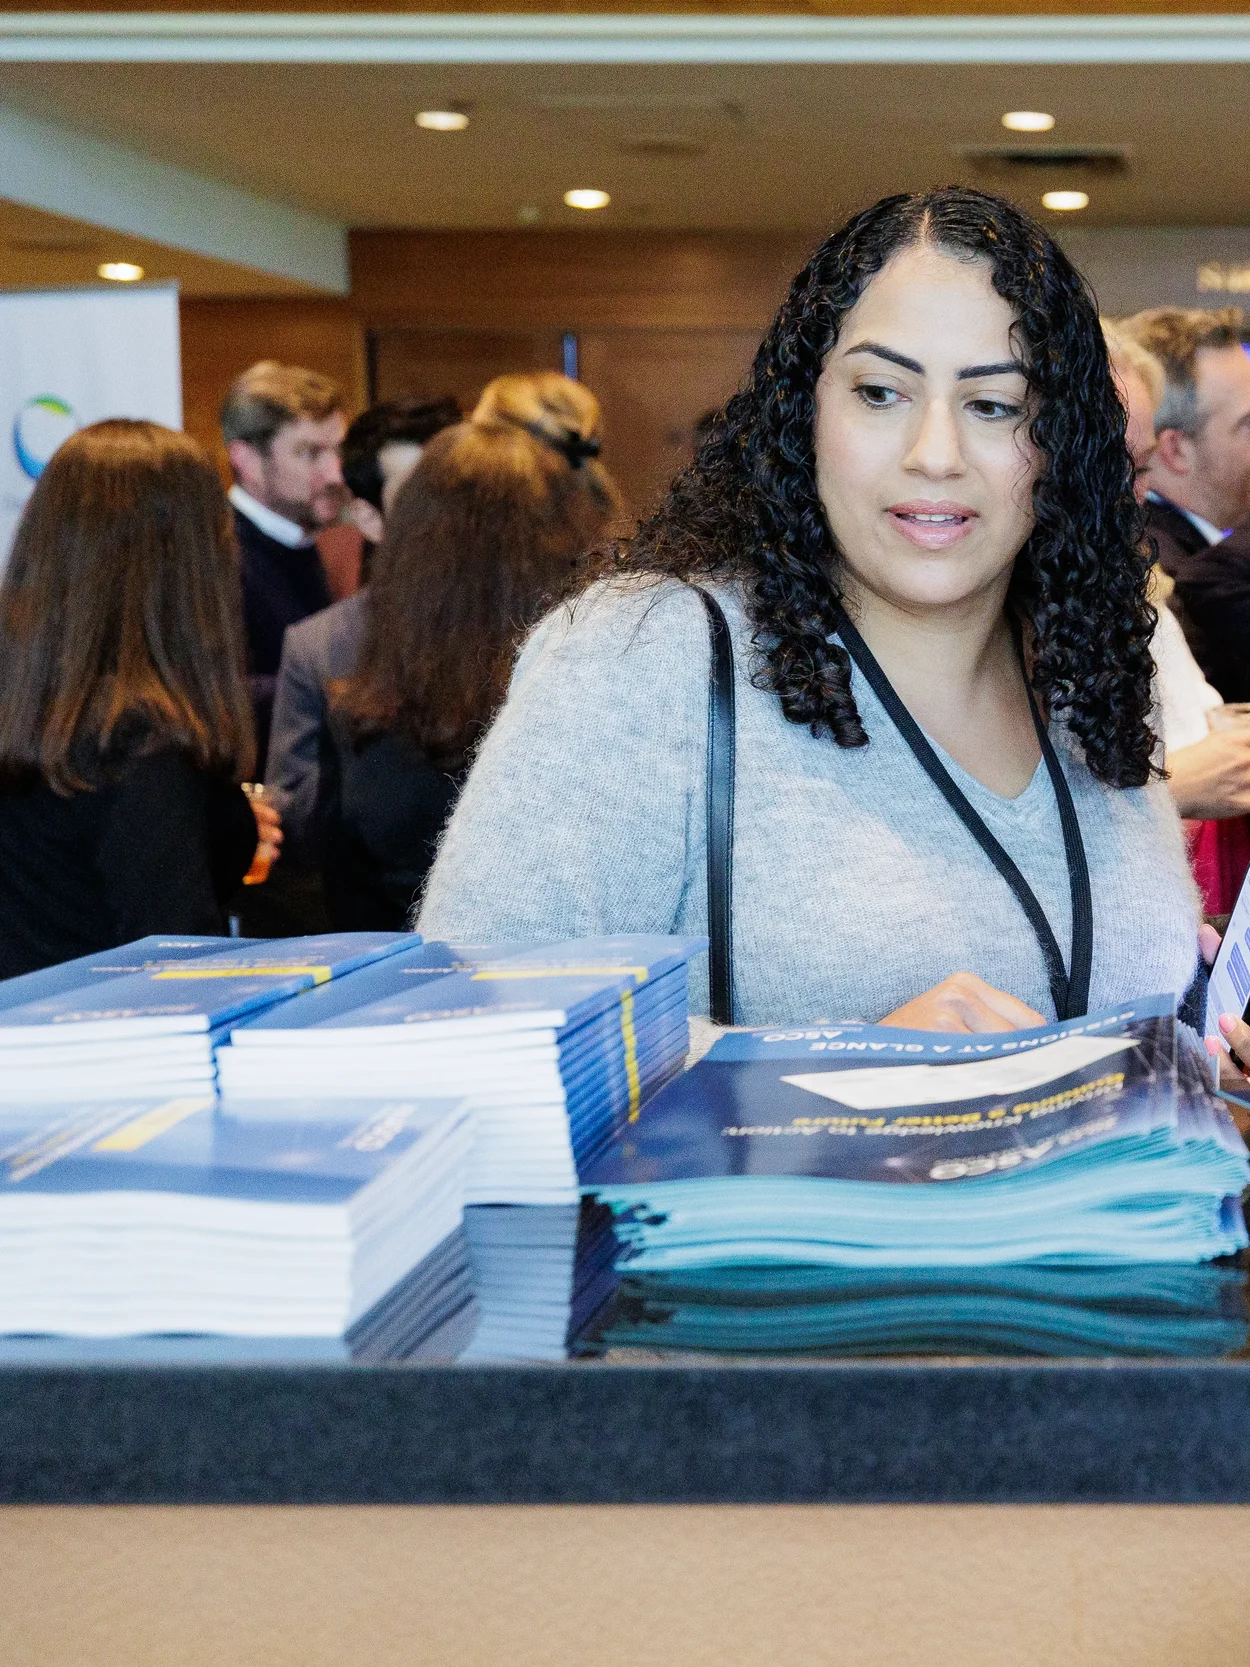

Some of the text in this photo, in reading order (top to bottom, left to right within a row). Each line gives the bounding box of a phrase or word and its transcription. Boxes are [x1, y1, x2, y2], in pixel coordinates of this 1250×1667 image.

[762, 1030, 844, 1043] ASCO
[807, 1011, 1136, 1054] SESSIONS AT A GLANCE
[791, 1116, 887, 1128] Future
[863, 1114, 1023, 1137] Knowledge
[893, 1112, 982, 1127] Better
[827, 1125, 858, 1137] to
